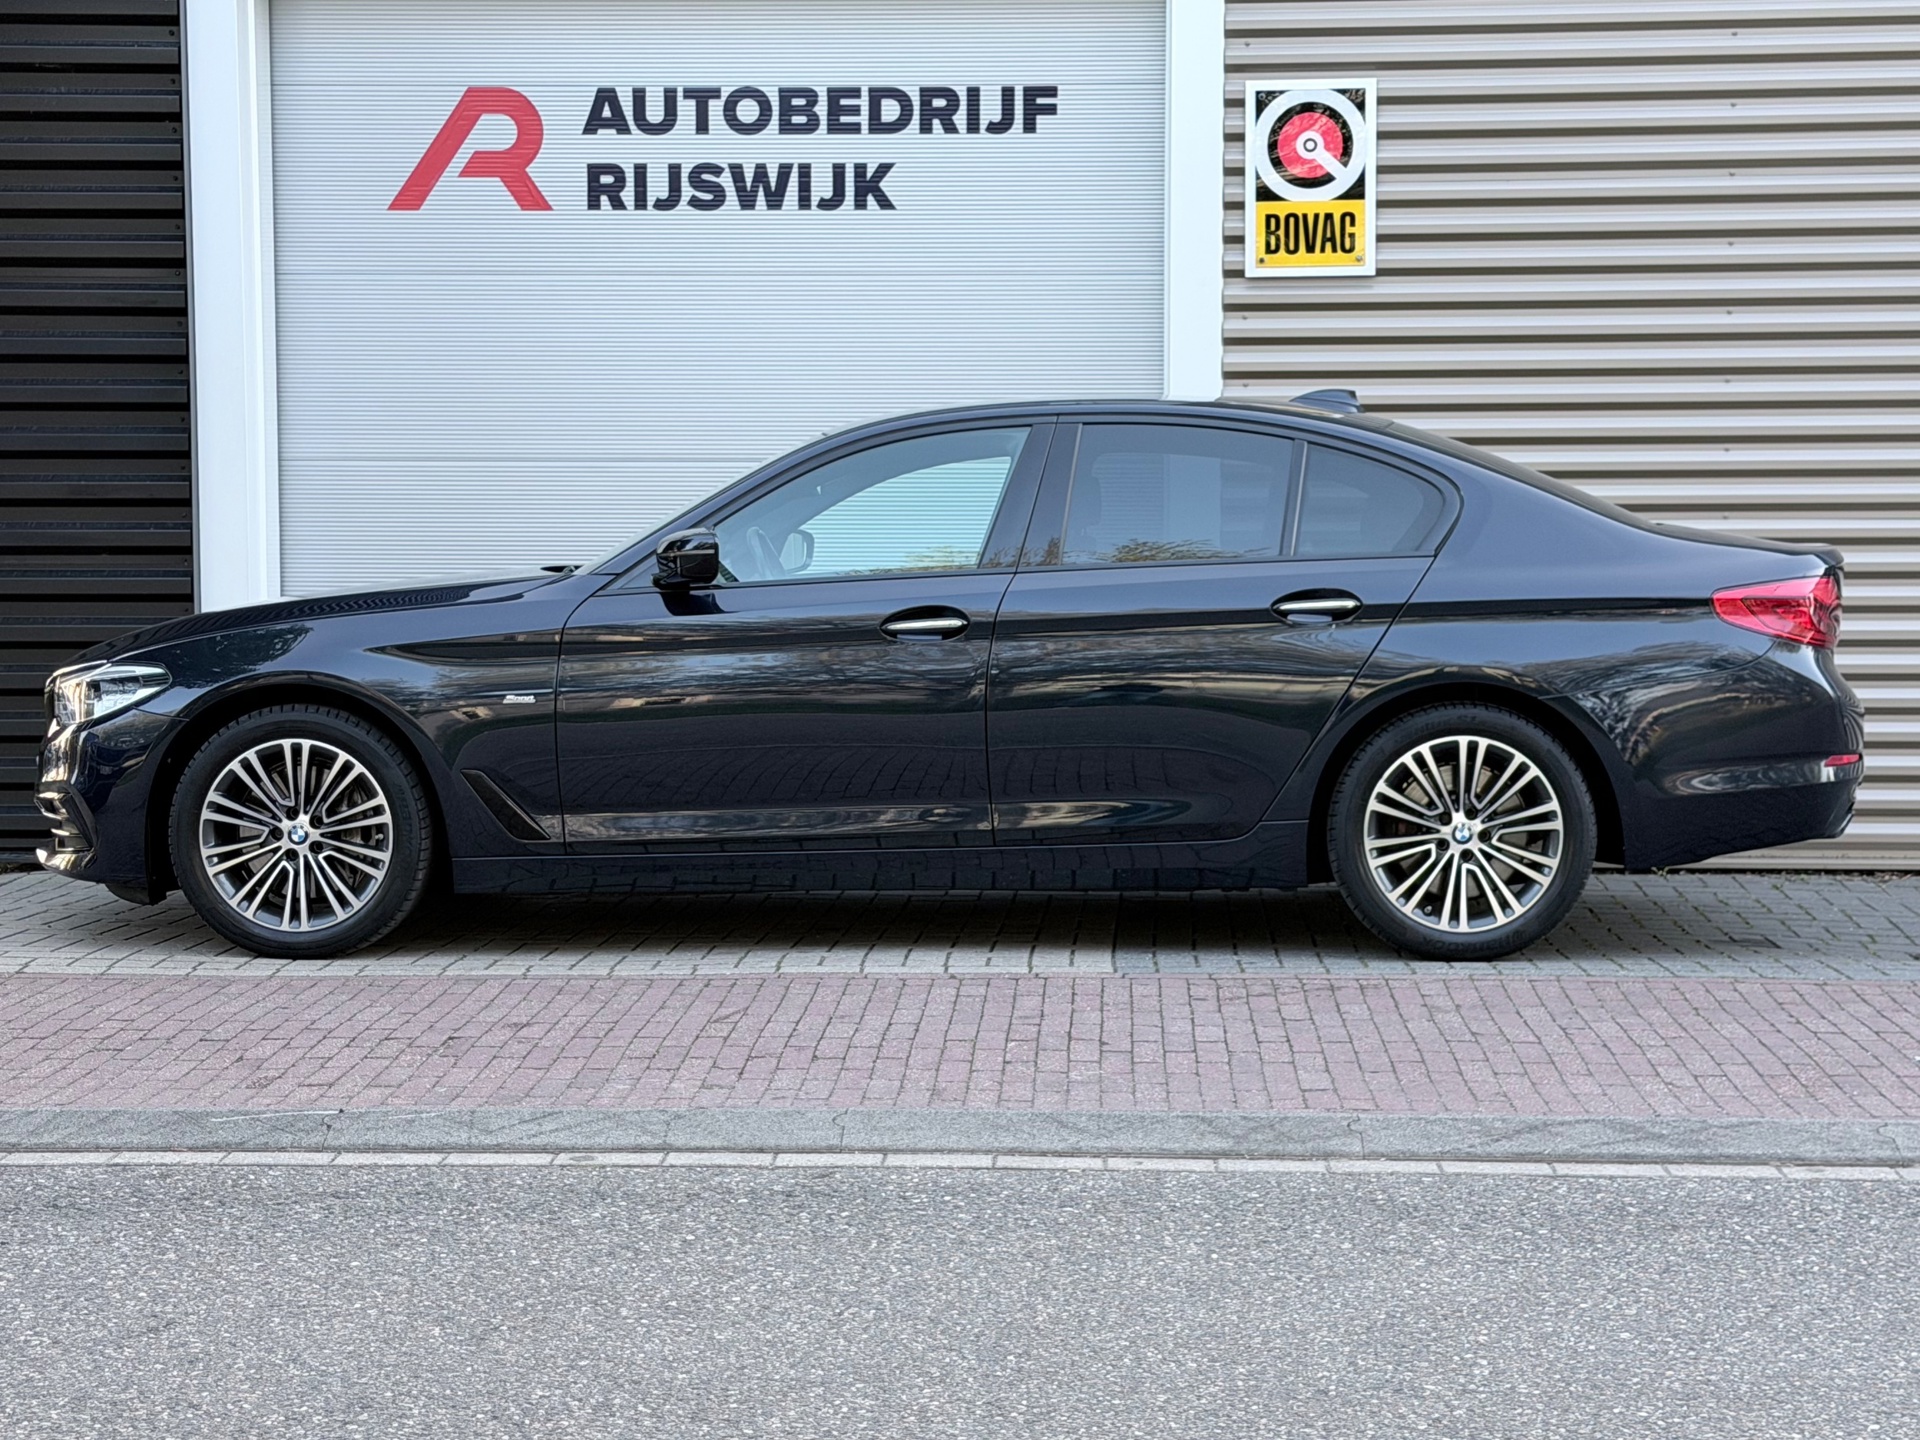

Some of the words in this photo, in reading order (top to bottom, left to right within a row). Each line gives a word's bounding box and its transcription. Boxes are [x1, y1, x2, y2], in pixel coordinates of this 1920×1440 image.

[582, 86, 1057, 135] AUTOBEDRIJF
[587, 162, 896, 211] RIJSWIJK
[1265, 211, 1356, 255] BOVAG
